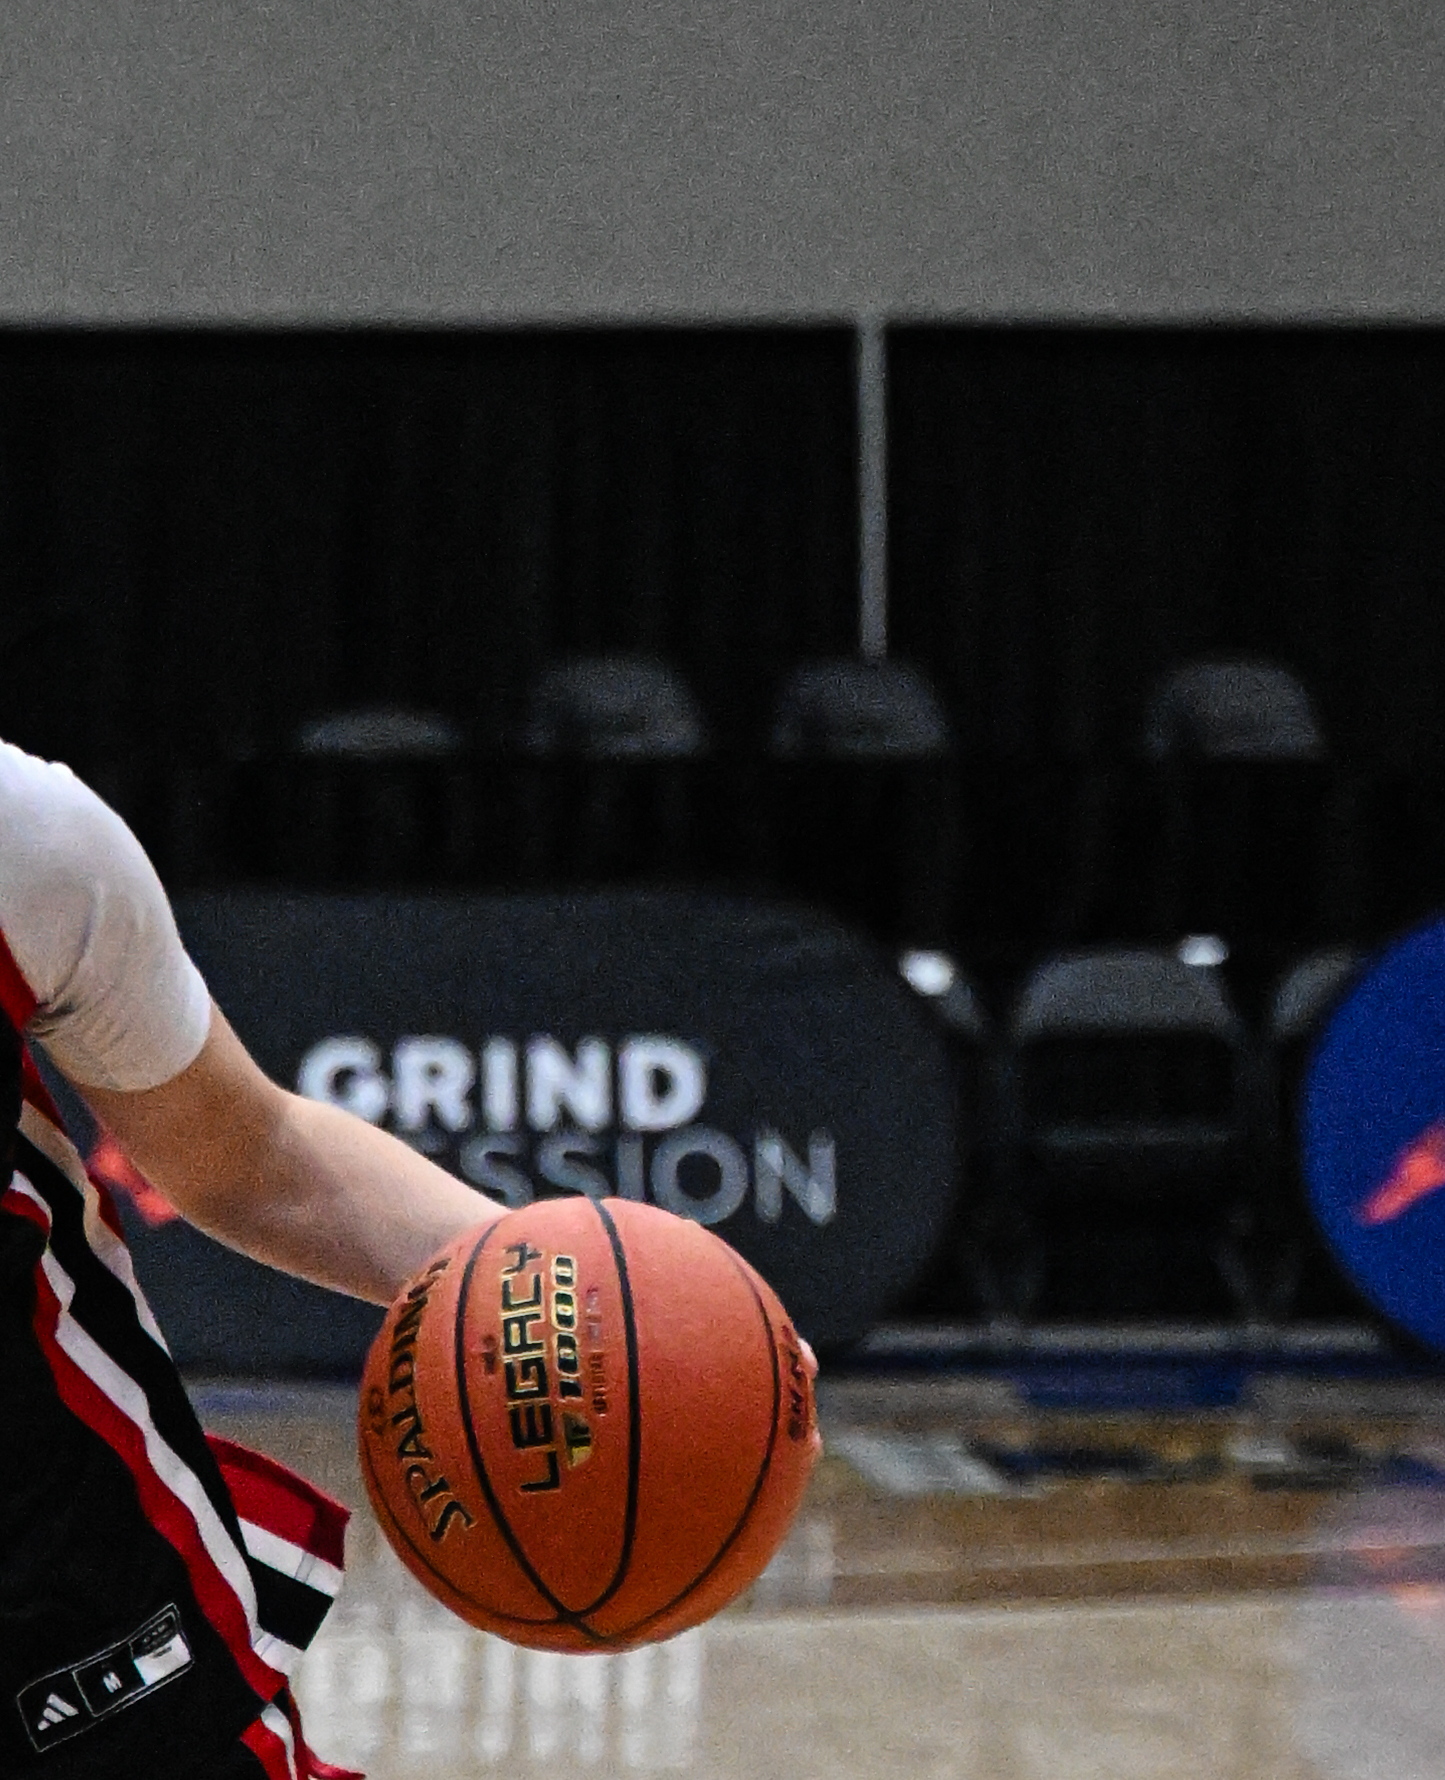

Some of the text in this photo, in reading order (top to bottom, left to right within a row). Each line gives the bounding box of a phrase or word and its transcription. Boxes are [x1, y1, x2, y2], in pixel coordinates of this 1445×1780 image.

[297, 1034, 706, 1132] GRIND
[409, 1124, 837, 1225] SSION
[501, 1242, 560, 1493] LEGACY
[551, 1253, 583, 1401] 1000
